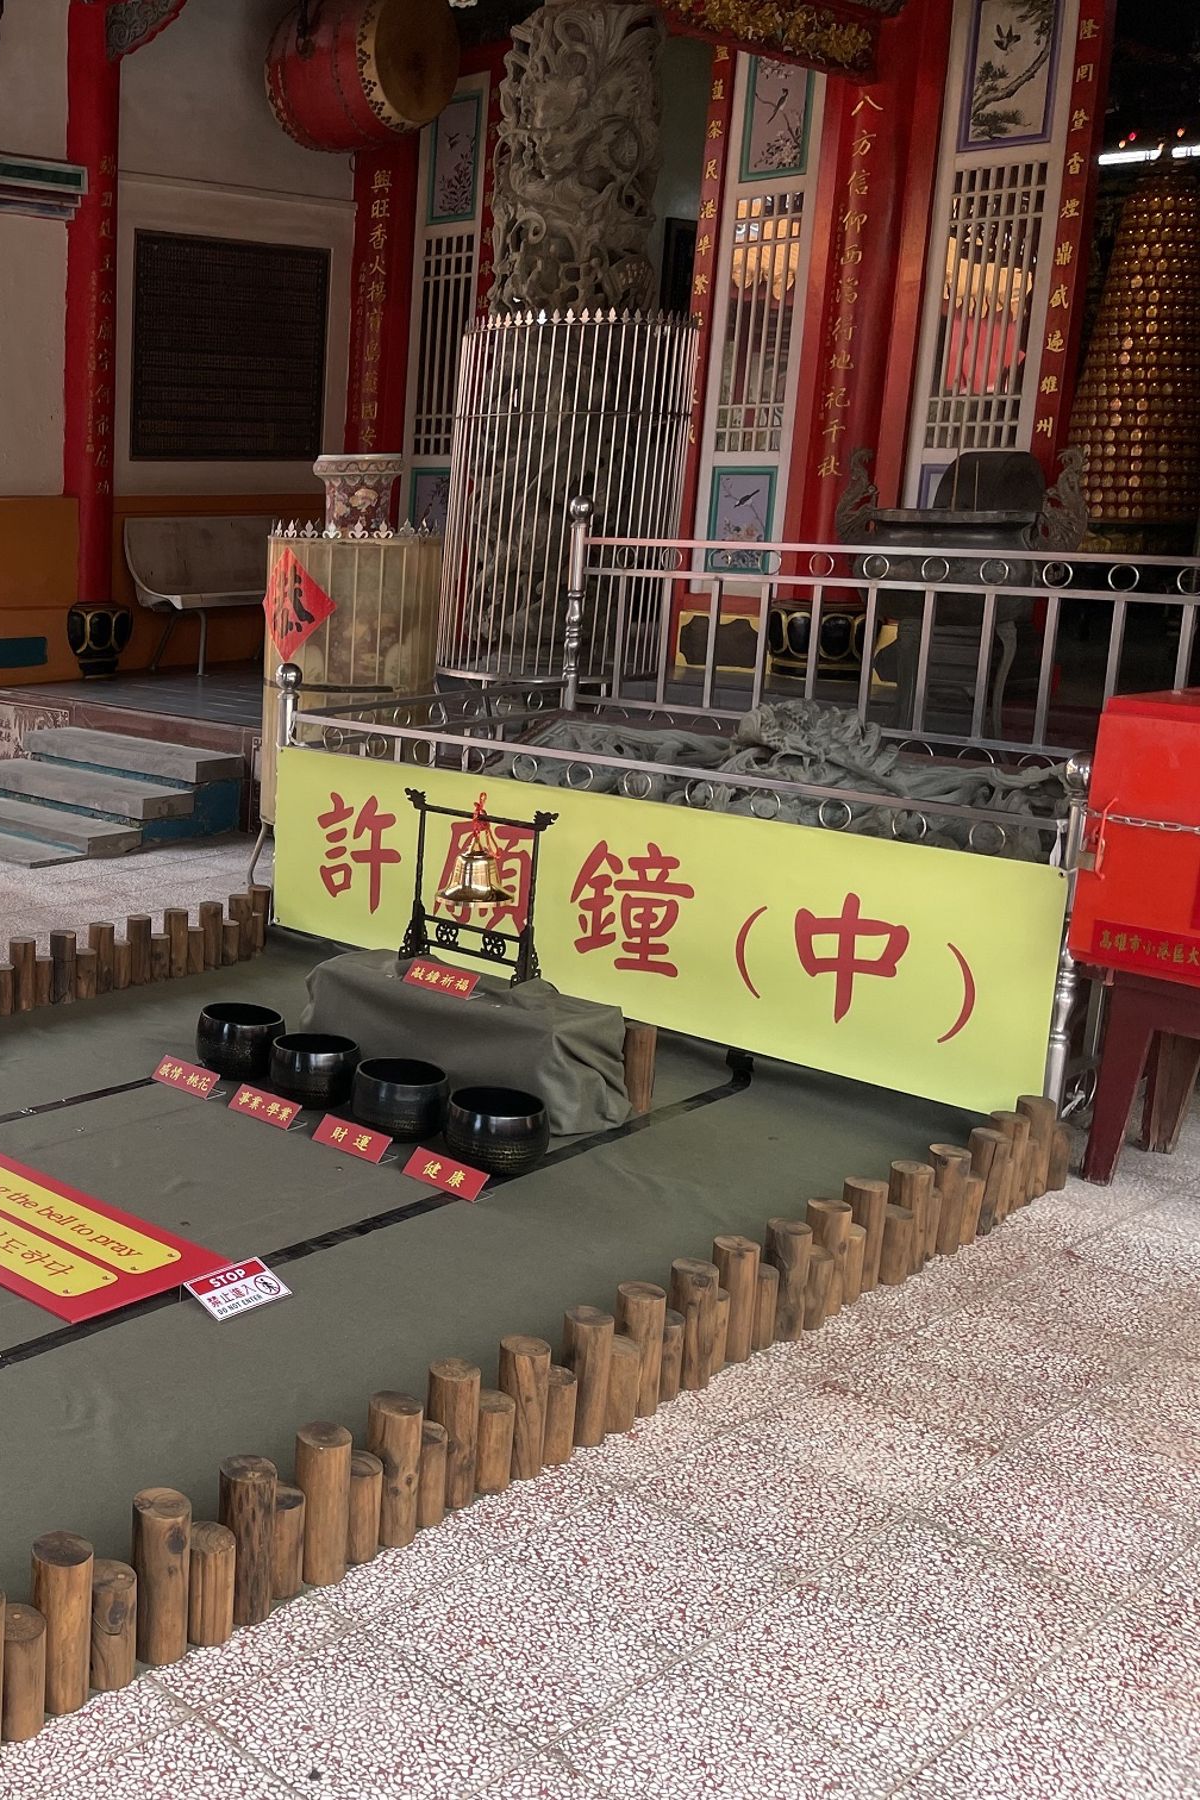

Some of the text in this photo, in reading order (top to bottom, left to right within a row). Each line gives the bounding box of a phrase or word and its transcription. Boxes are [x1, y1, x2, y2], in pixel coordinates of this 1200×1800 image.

[411, 966, 470, 992] 敲鐘祈福
[330, 1126, 373, 1152] 財運
[422, 1160, 466, 1188] 健康
[6, 1189, 39, 1211] the
[36, 1203, 75, 1229] bell
[70, 1220, 95, 1237] to
[90, 1234, 144, 1259] pray
[209, 1268, 246, 1288] STOP
[206, 1283, 257, 1308] 禁止進入
[217, 1293, 264, 1315] DO NOT ENTER
